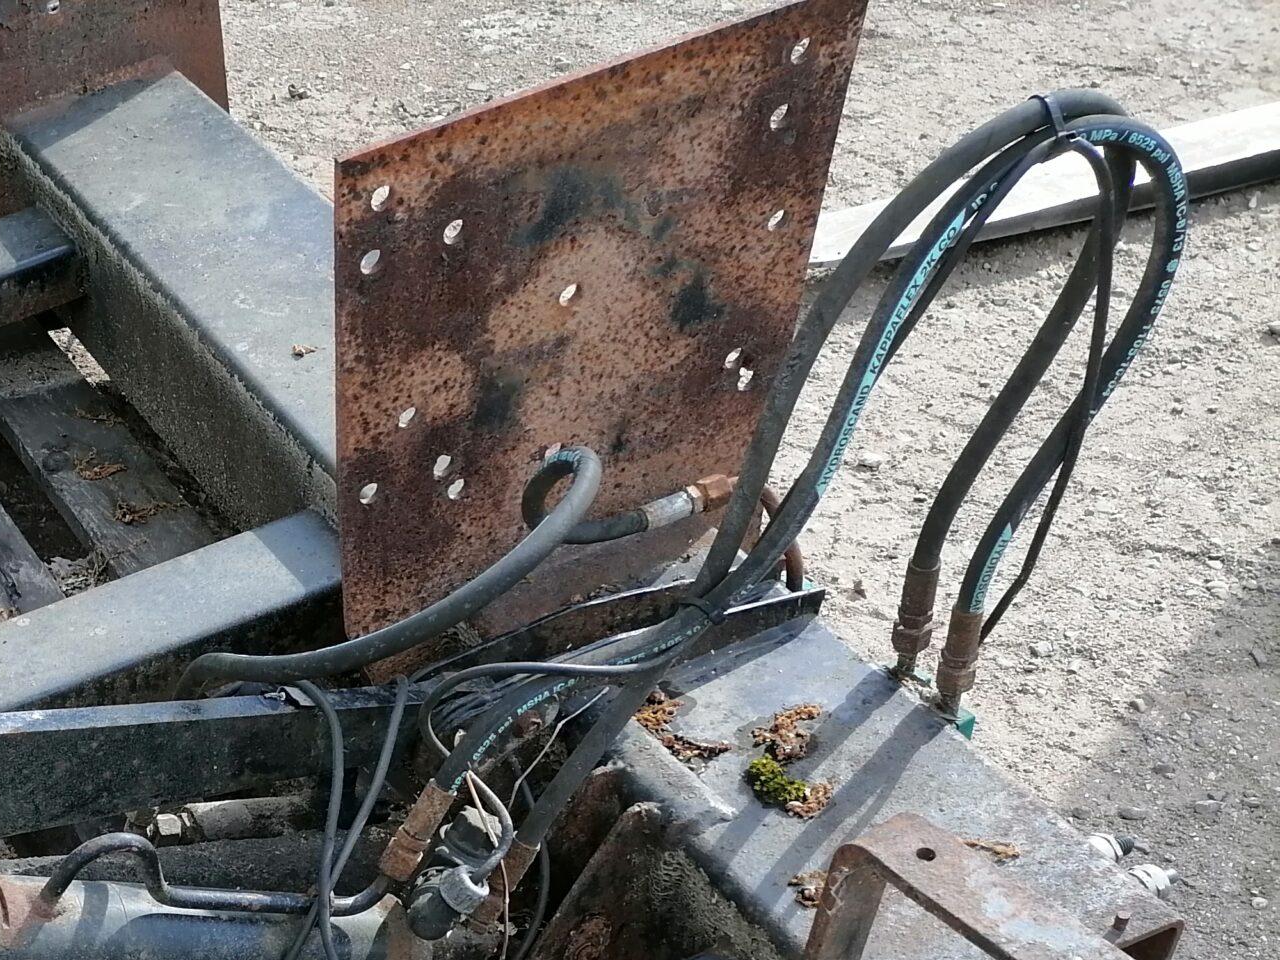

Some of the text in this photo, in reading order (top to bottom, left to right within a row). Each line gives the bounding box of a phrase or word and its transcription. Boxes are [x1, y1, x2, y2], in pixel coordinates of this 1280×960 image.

[1089, 129, 1119, 141] MPa
[1128, 132, 1158, 151] 6525
[1166, 162, 1186, 201] MSHA
[819, 383, 870, 487] HYDROSCAND
[869, 278, 920, 375] KAPPAFLEX
[516, 690, 551, 716] MSHA
